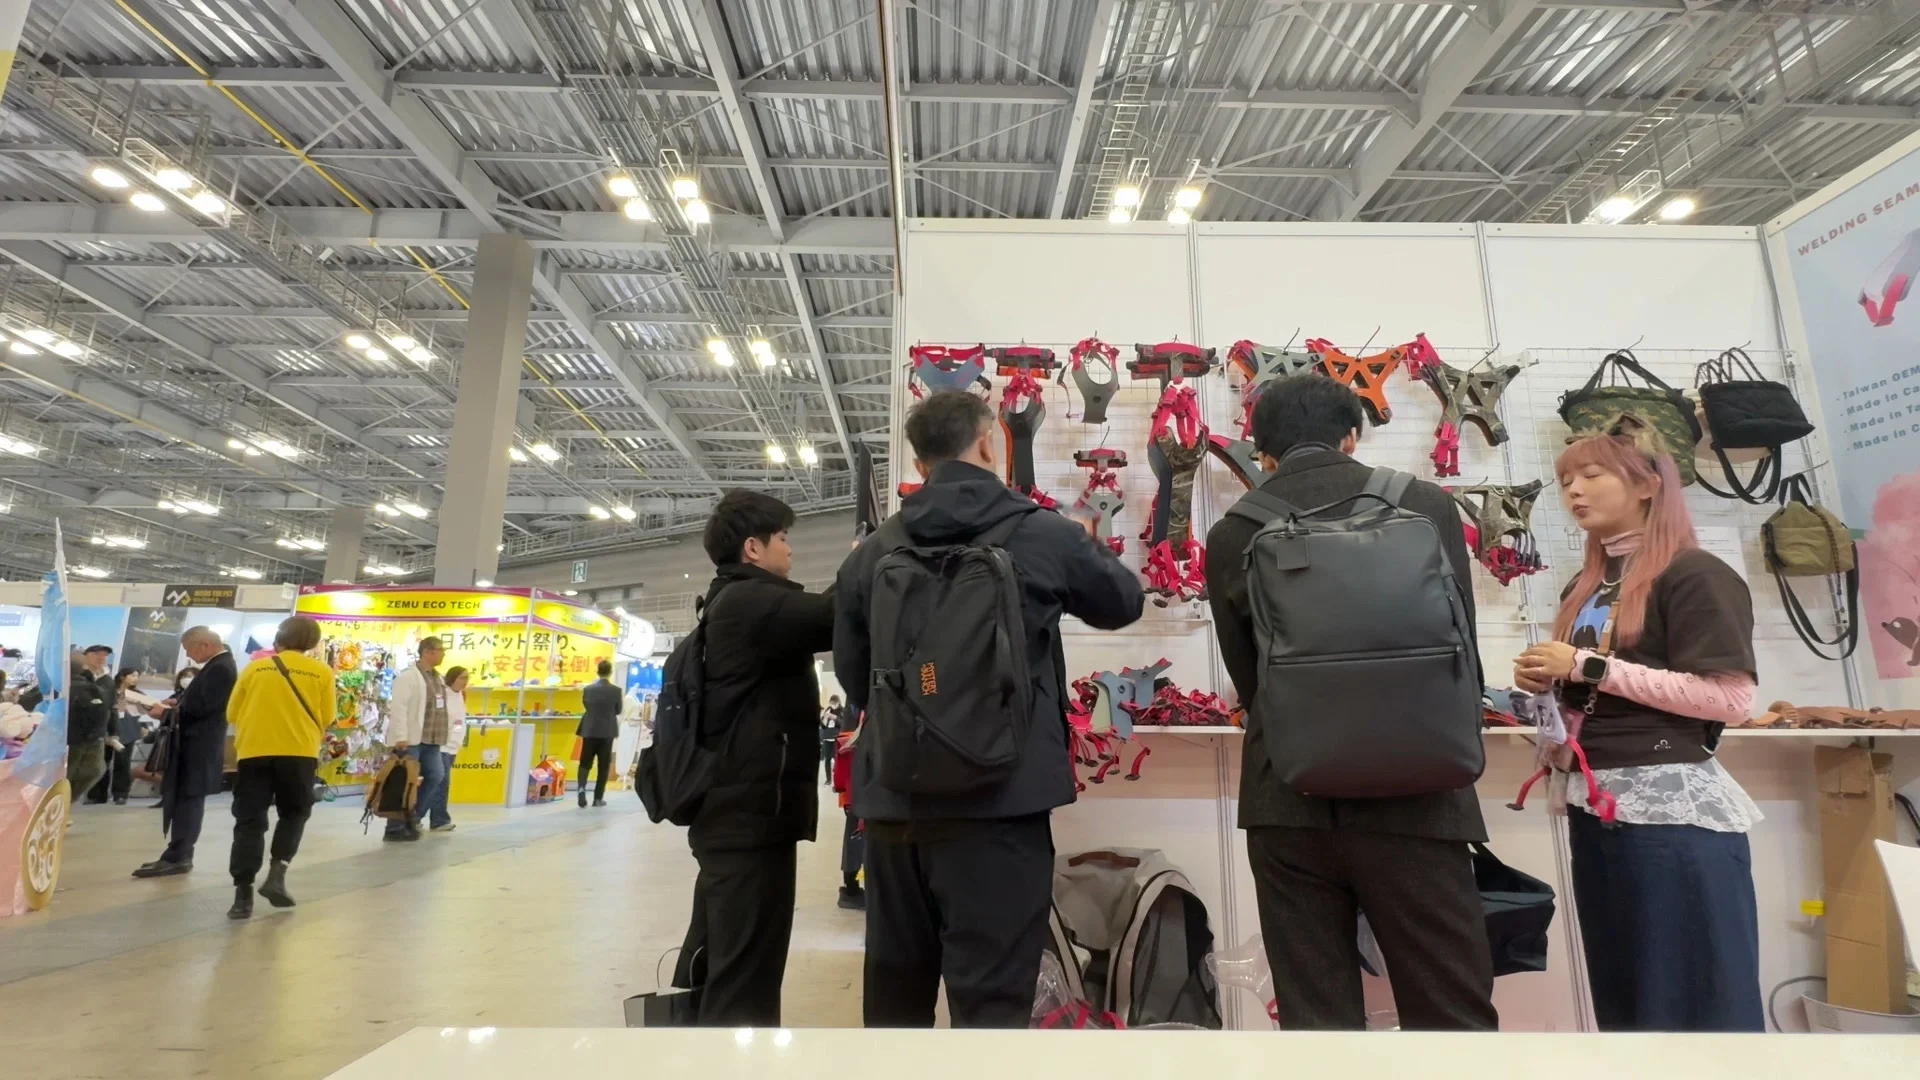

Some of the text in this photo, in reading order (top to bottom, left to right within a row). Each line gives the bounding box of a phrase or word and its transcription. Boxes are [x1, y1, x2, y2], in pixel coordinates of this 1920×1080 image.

[1798, 182, 1920, 256] WELDING SEAM
[1842, 365, 1920, 400] Taiwan OEM
[1846, 399, 1881, 416] Made
[1850, 416, 1884, 432] Made
[1889, 411, 1902, 420] in
[1853, 435, 1889, 450] Made
[387, 600, 481, 609] ZEMU ECO TECH
[461, 762, 480, 770] eco
[480, 761, 503, 770] tech
